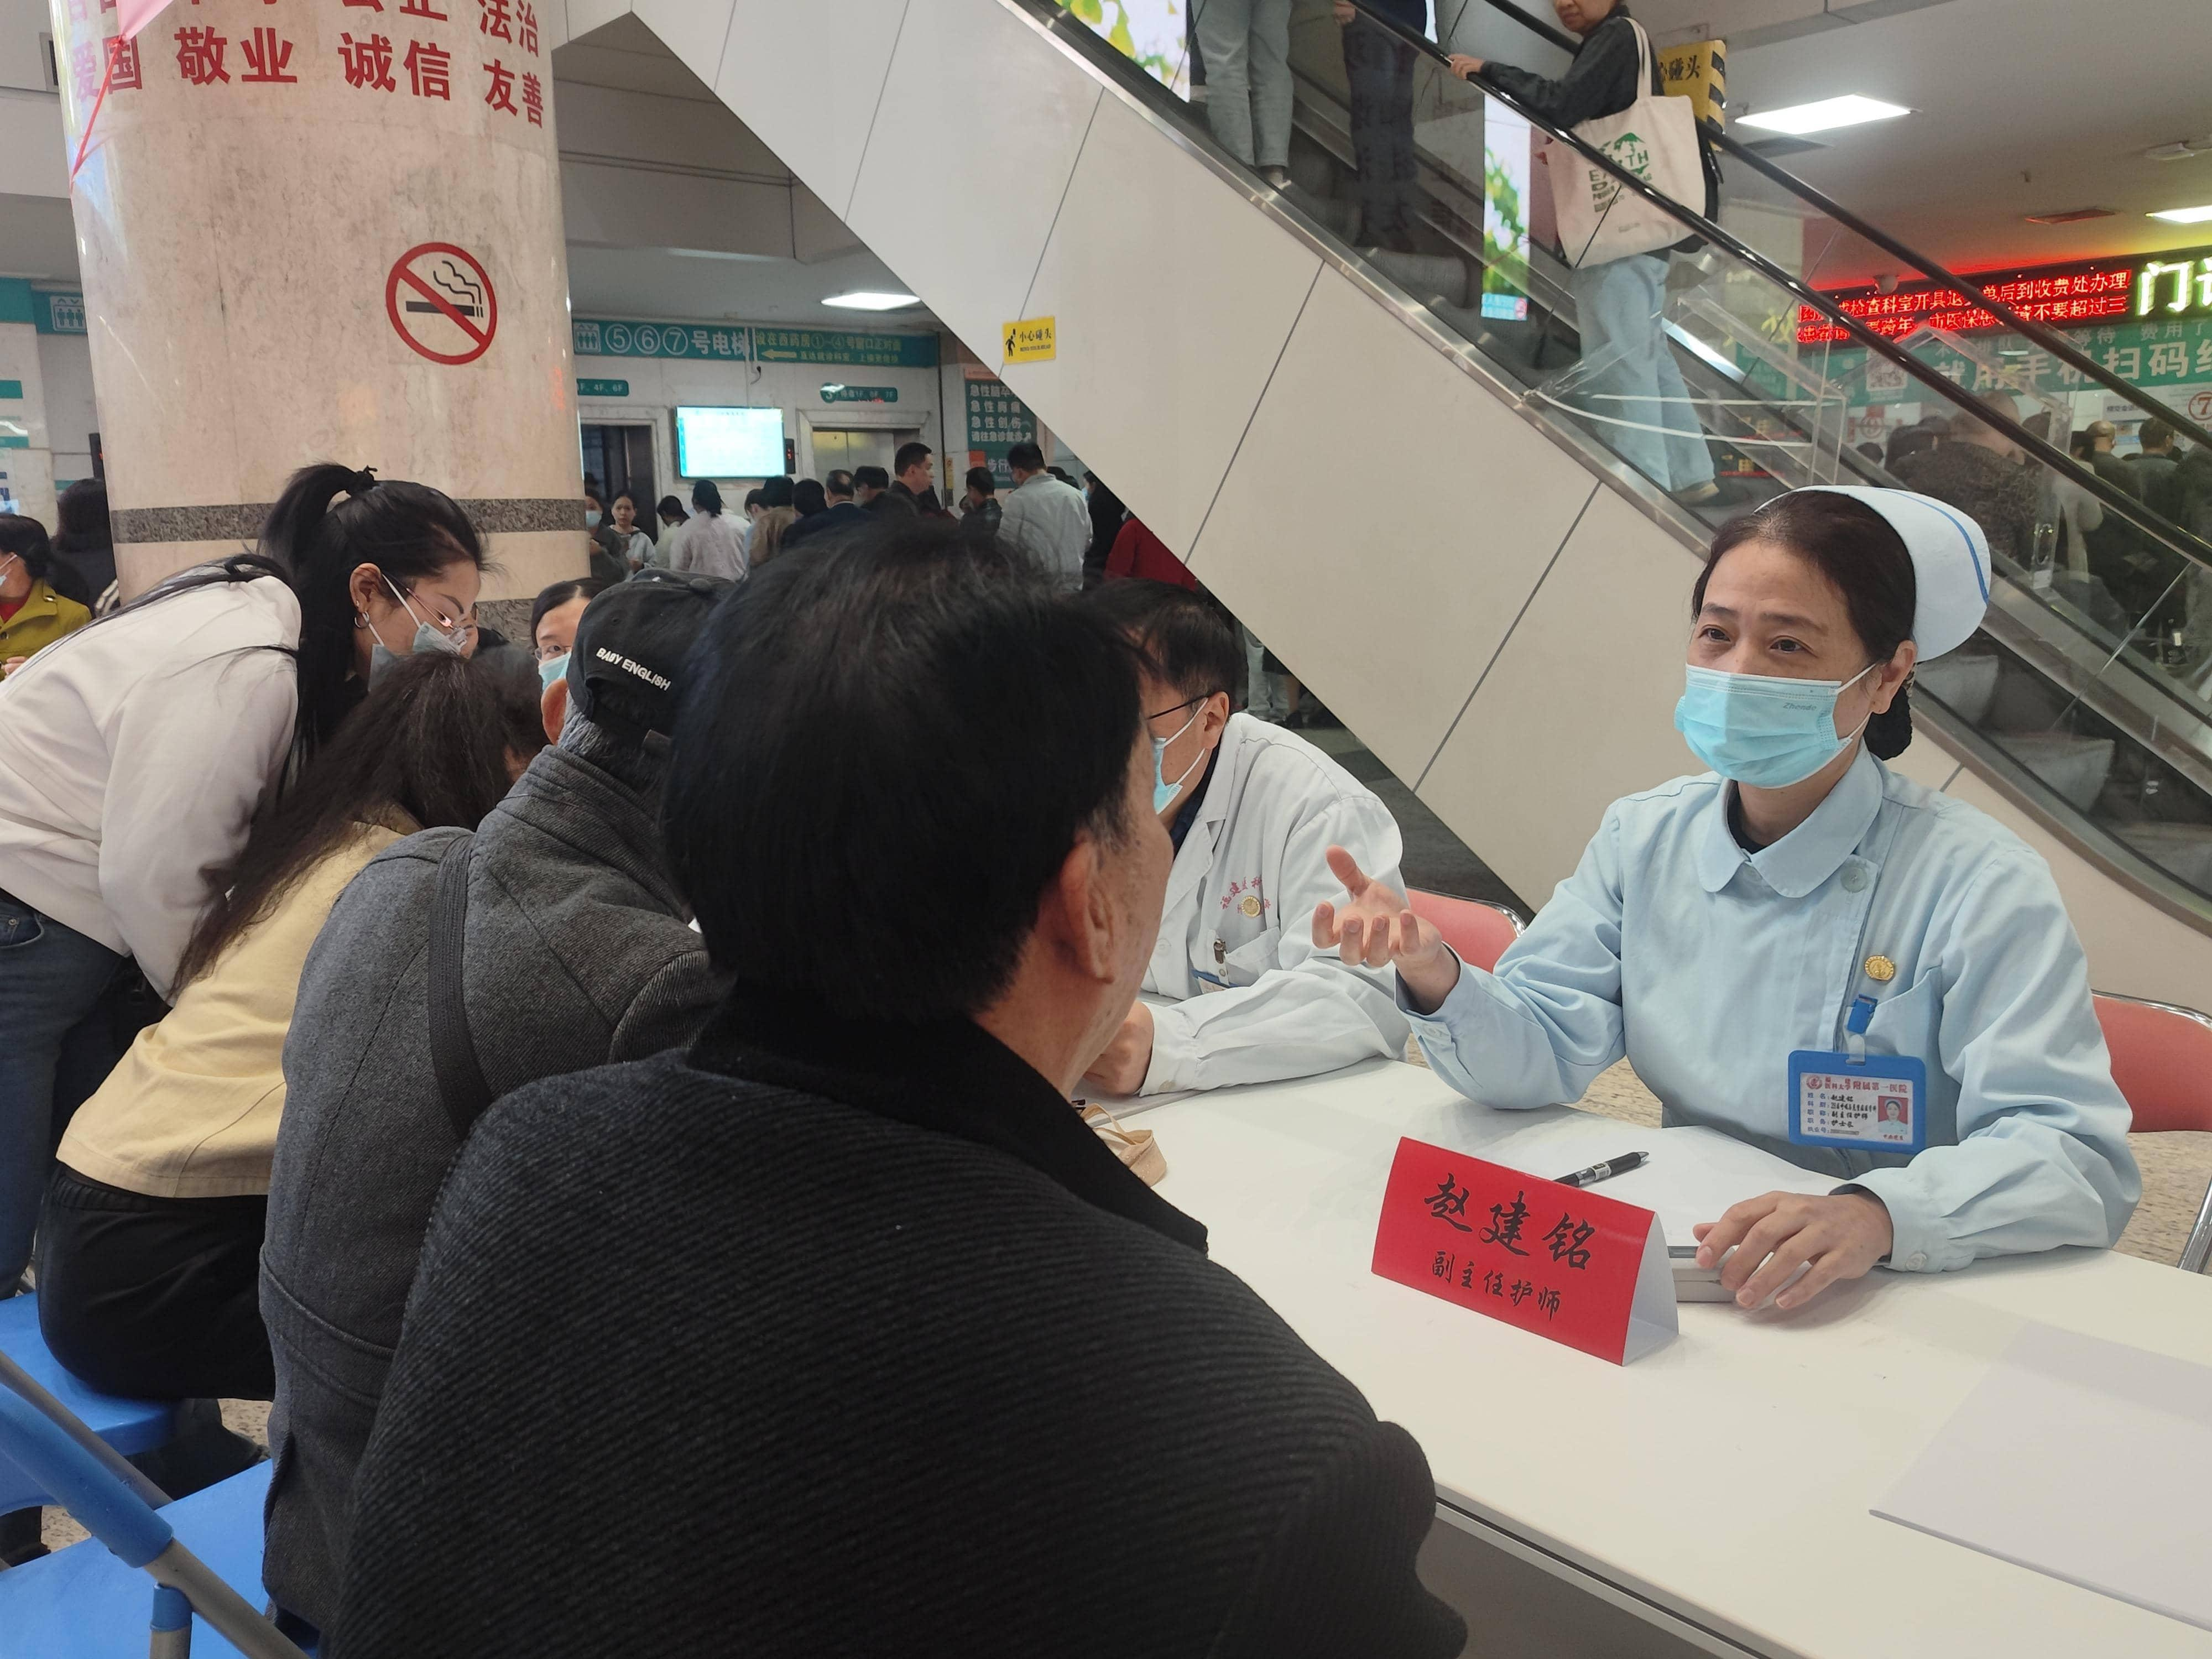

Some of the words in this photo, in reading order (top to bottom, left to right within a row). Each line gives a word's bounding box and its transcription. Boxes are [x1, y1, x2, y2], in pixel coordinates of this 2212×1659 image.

[72, 34, 143, 102] 爱国
[174, 25, 298, 85] 敬业
[337, 32, 451, 101] 诚信
[482, 58, 544, 128] 友善
[596, 648, 623, 665] BABY
[622, 658, 672, 691] ENGLISH
[1425, 1173, 1597, 1270] 赵建铭
[1432, 1251, 1562, 1322] 副主任护师
